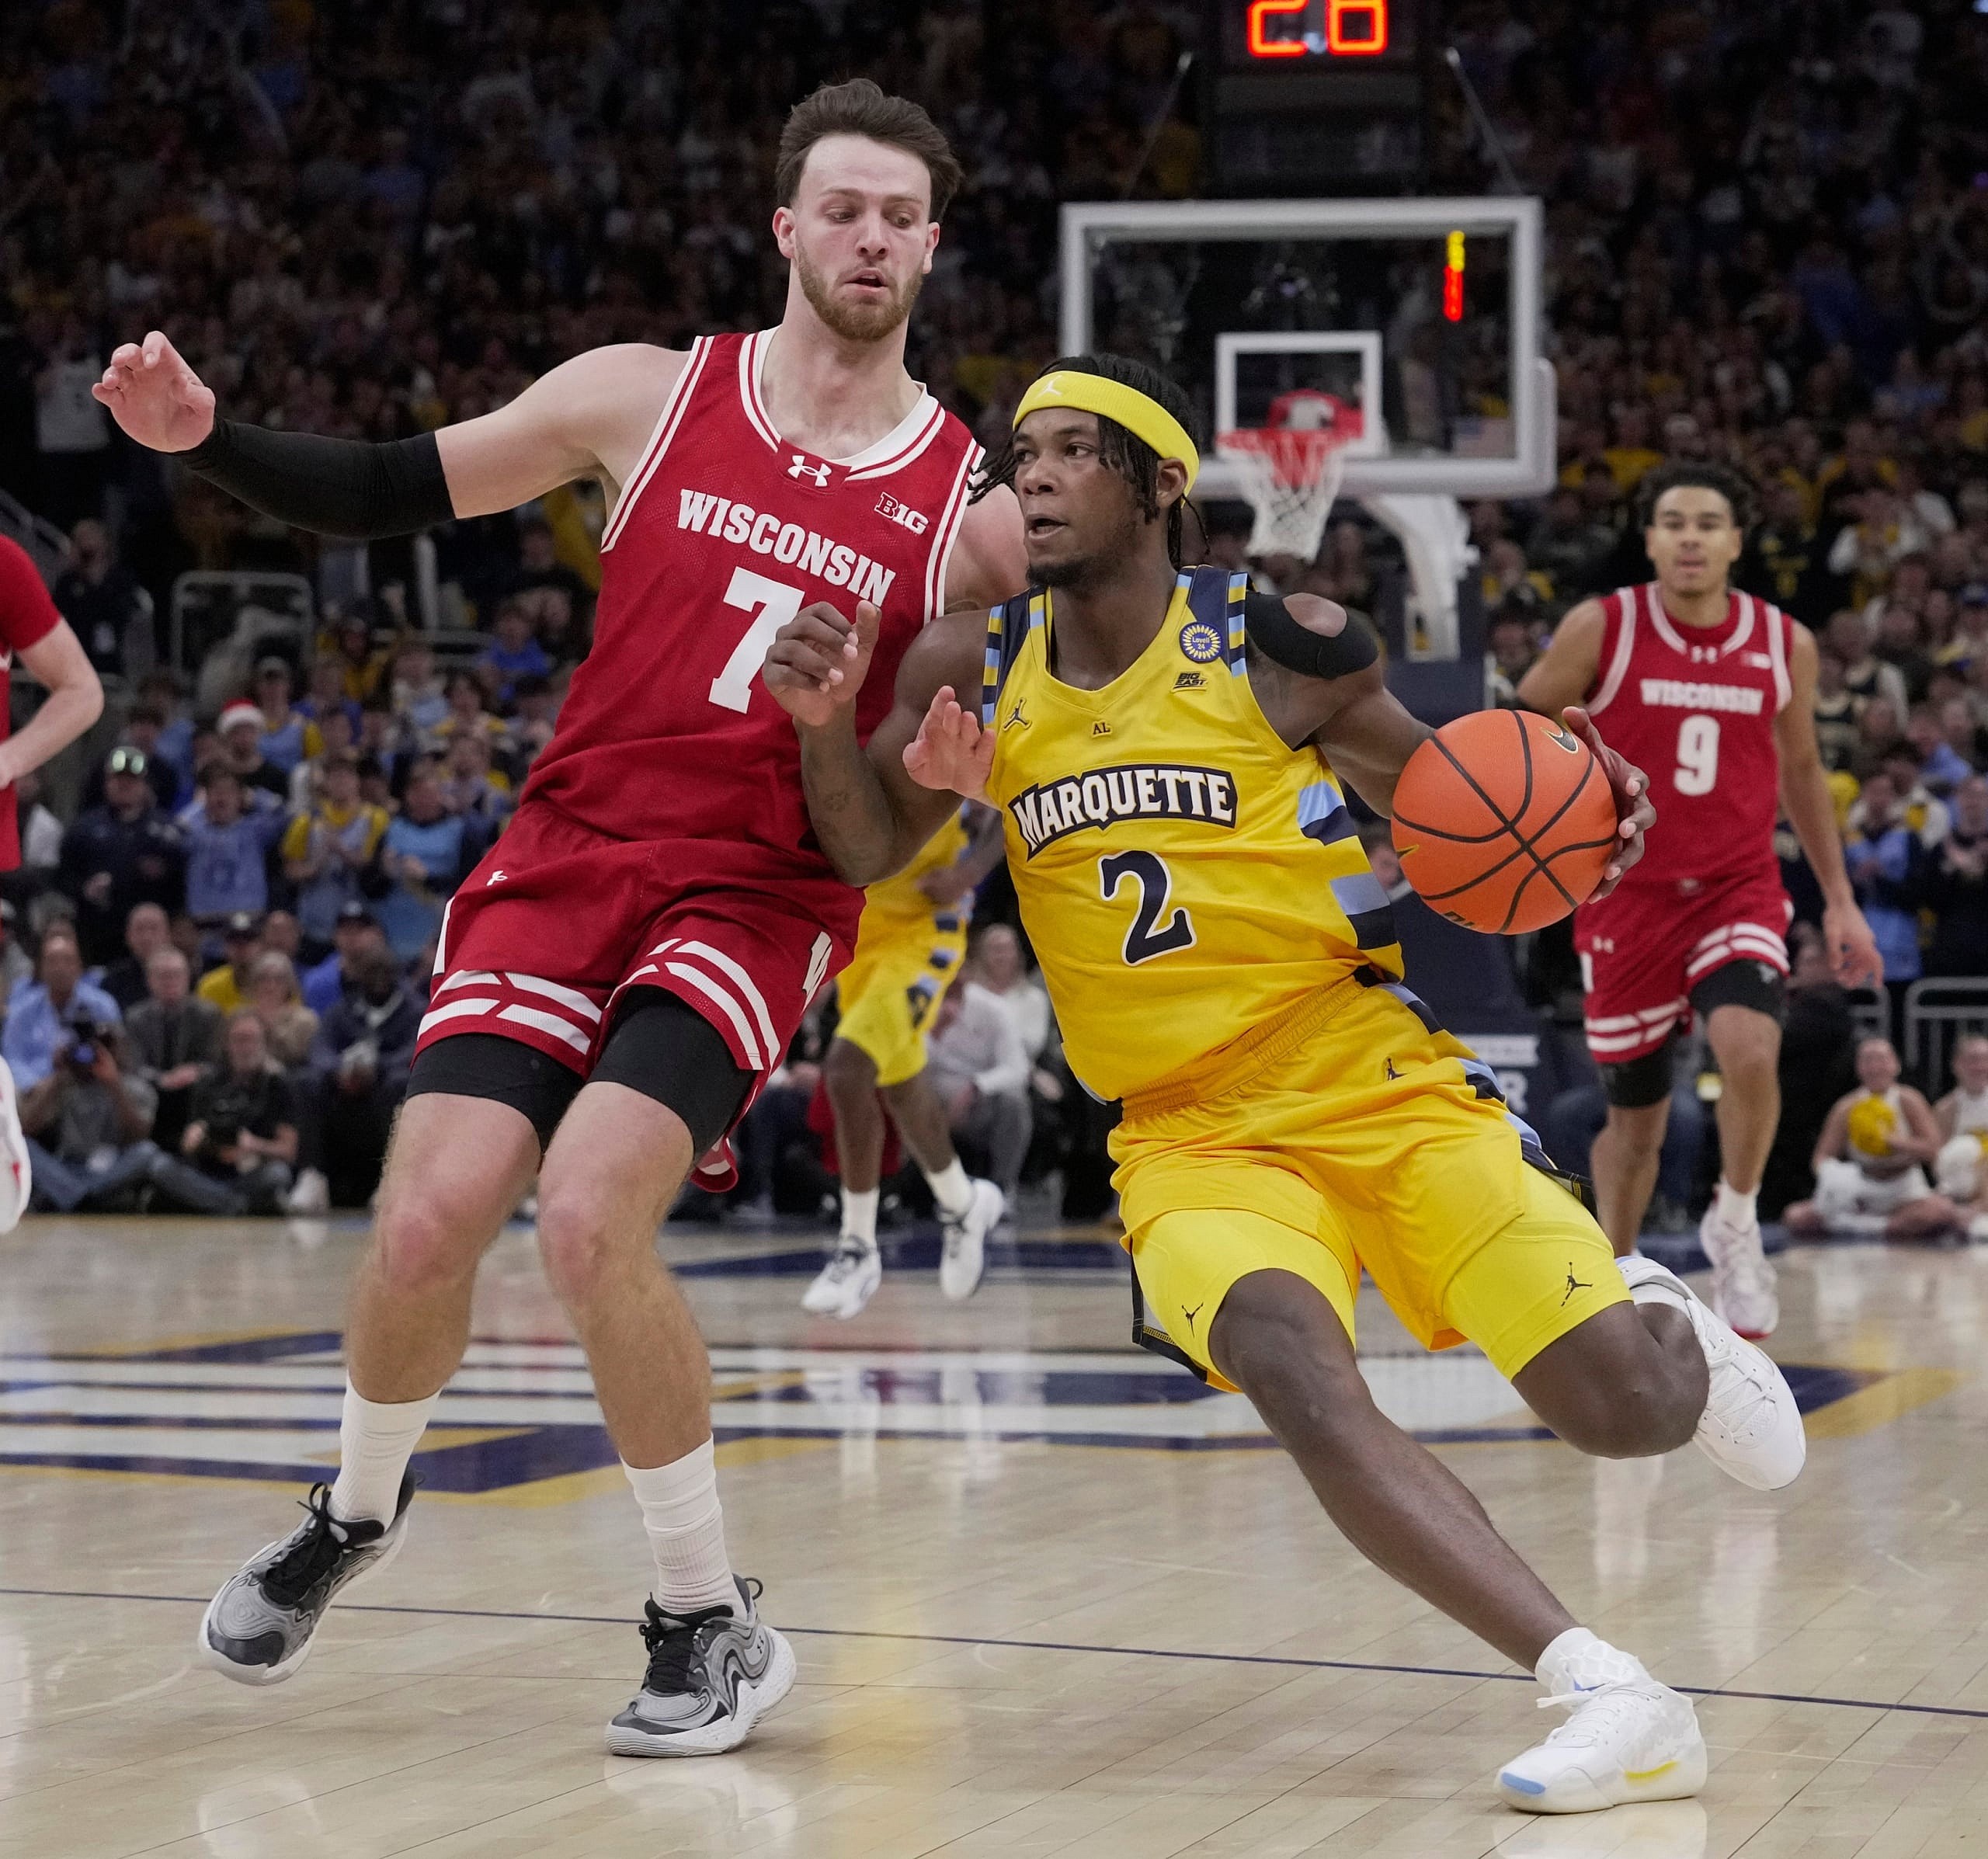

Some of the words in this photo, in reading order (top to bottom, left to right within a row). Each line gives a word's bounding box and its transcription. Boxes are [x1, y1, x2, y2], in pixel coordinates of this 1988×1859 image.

[678, 488, 896, 607] WISCONSIN
[707, 566, 806, 714] 7
[1093, 723, 1111, 735] AL
[1673, 714, 1721, 797] 9
[1012, 767, 1233, 850] MARQUETTE
[1097, 849, 1198, 968] 2
